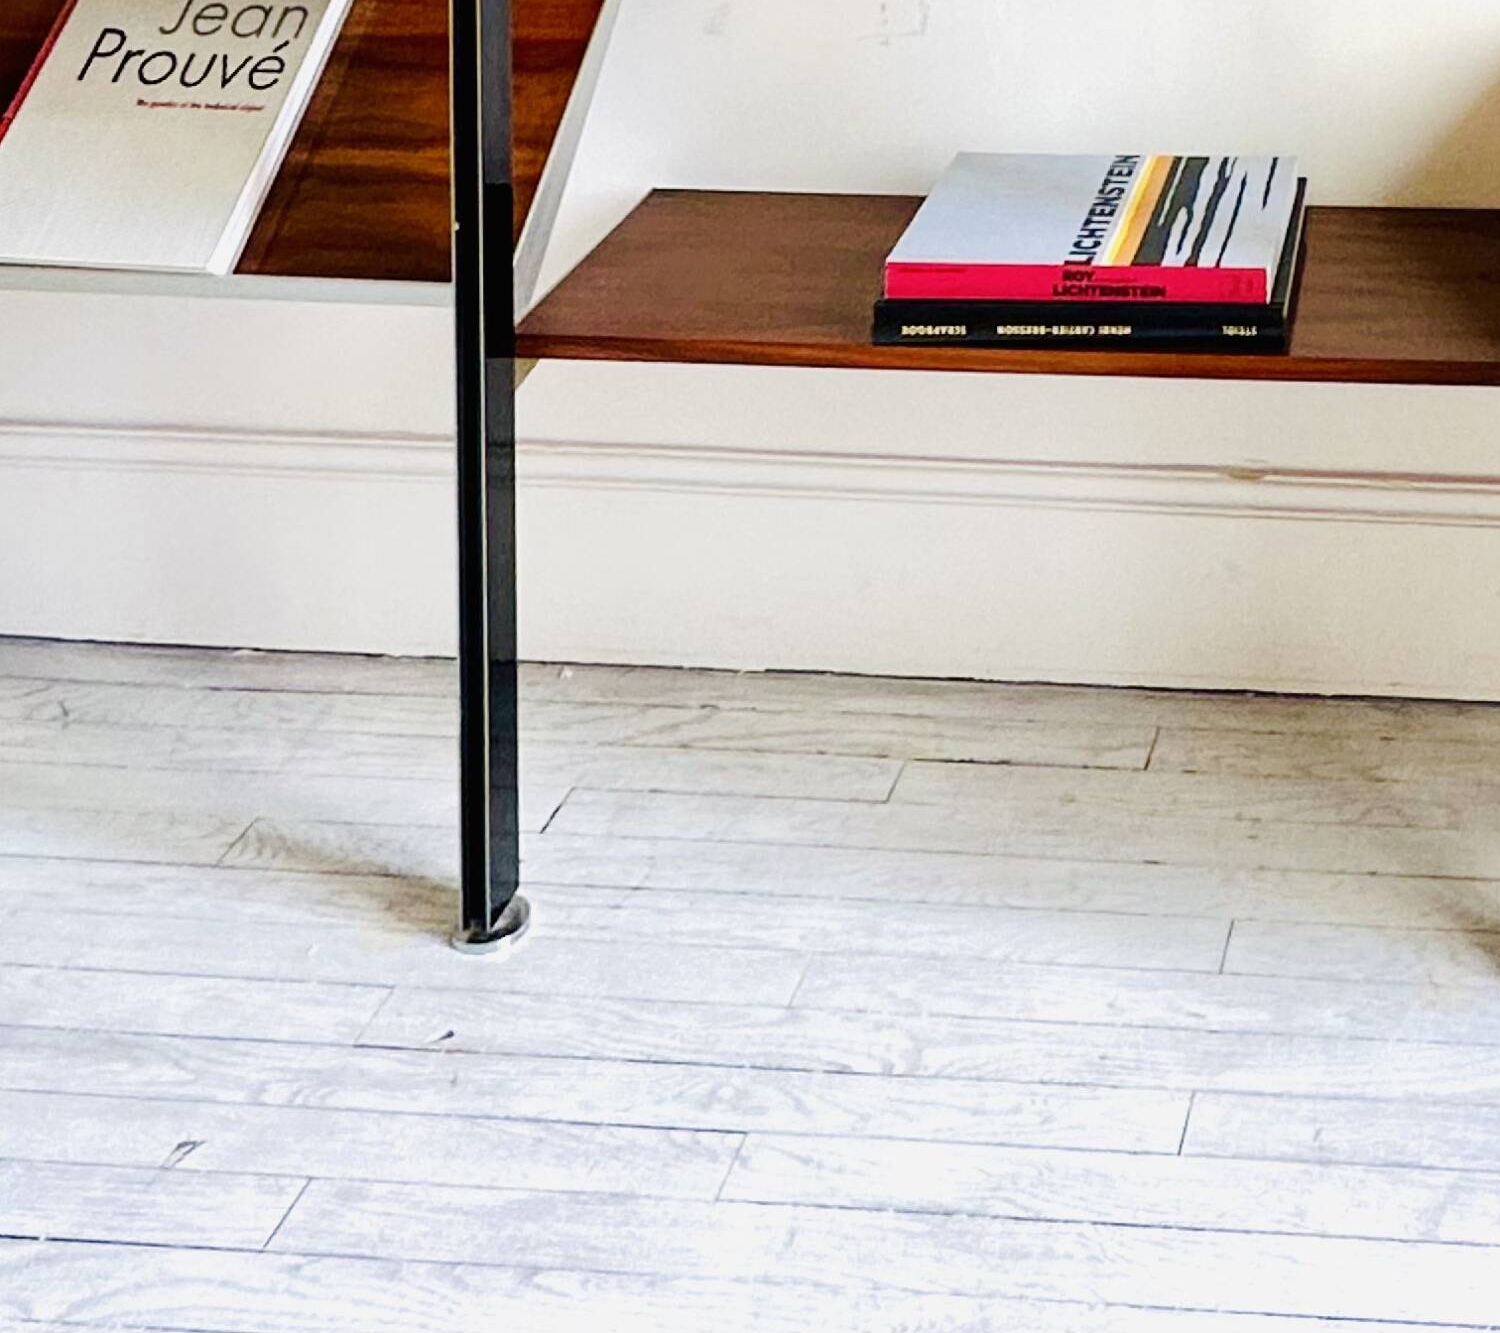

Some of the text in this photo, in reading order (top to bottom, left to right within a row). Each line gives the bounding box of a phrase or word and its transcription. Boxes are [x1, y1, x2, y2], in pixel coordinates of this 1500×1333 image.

[77, 27, 290, 91] Prouvé
[1064, 155, 1140, 265] LICHTENSTEIN
[1062, 270, 1096, 282] ROY
[1053, 284, 1167, 298] LICHTENSTEIN
[901, 325, 967, 336] SCRAPBOOK
